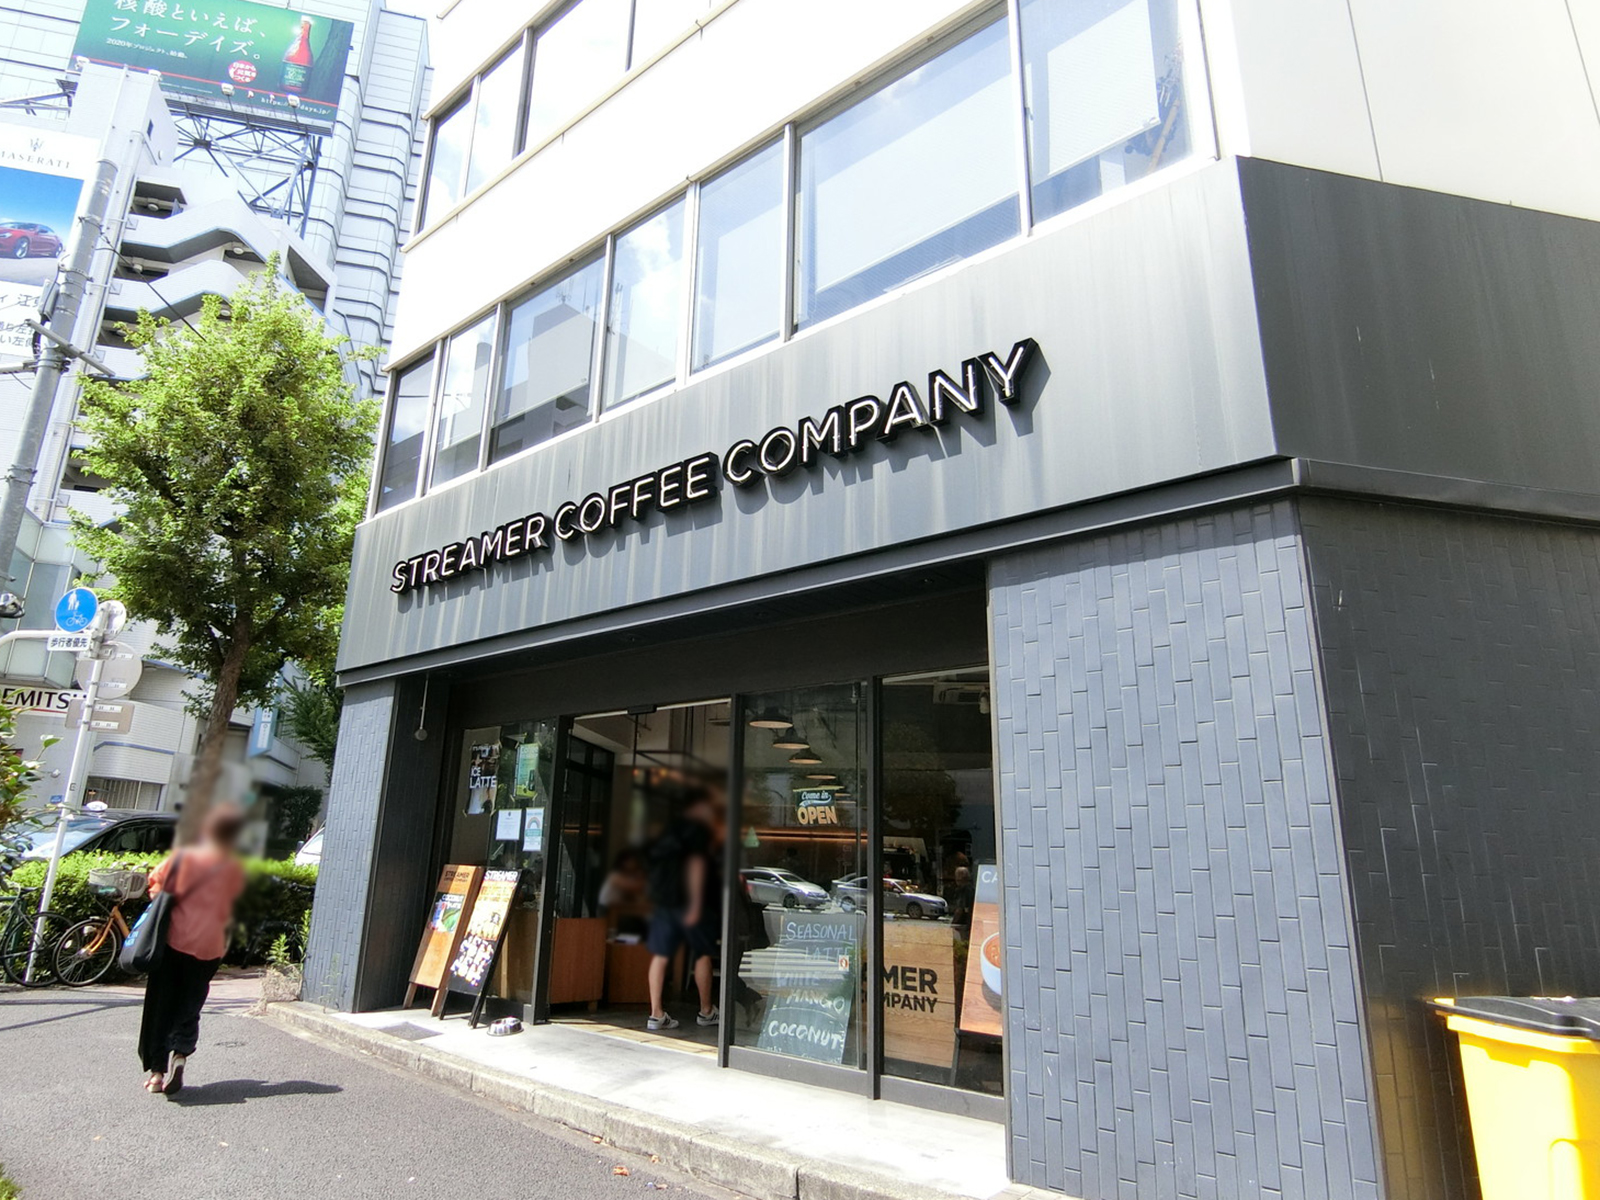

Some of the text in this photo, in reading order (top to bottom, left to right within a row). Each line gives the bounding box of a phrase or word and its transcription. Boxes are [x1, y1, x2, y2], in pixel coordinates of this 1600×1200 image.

[389, 337, 1042, 595] STREAMER COFFEE COMPANY
[50, 637, 88, 648] 歩行者優先
[2, 687, 87, 709] EMITS
[469, 775, 497, 788] LATTE
[797, 806, 838, 825] OPEN
[786, 921, 858, 942] SEASONAL
[768, 1020, 844, 1050] COCONUT
